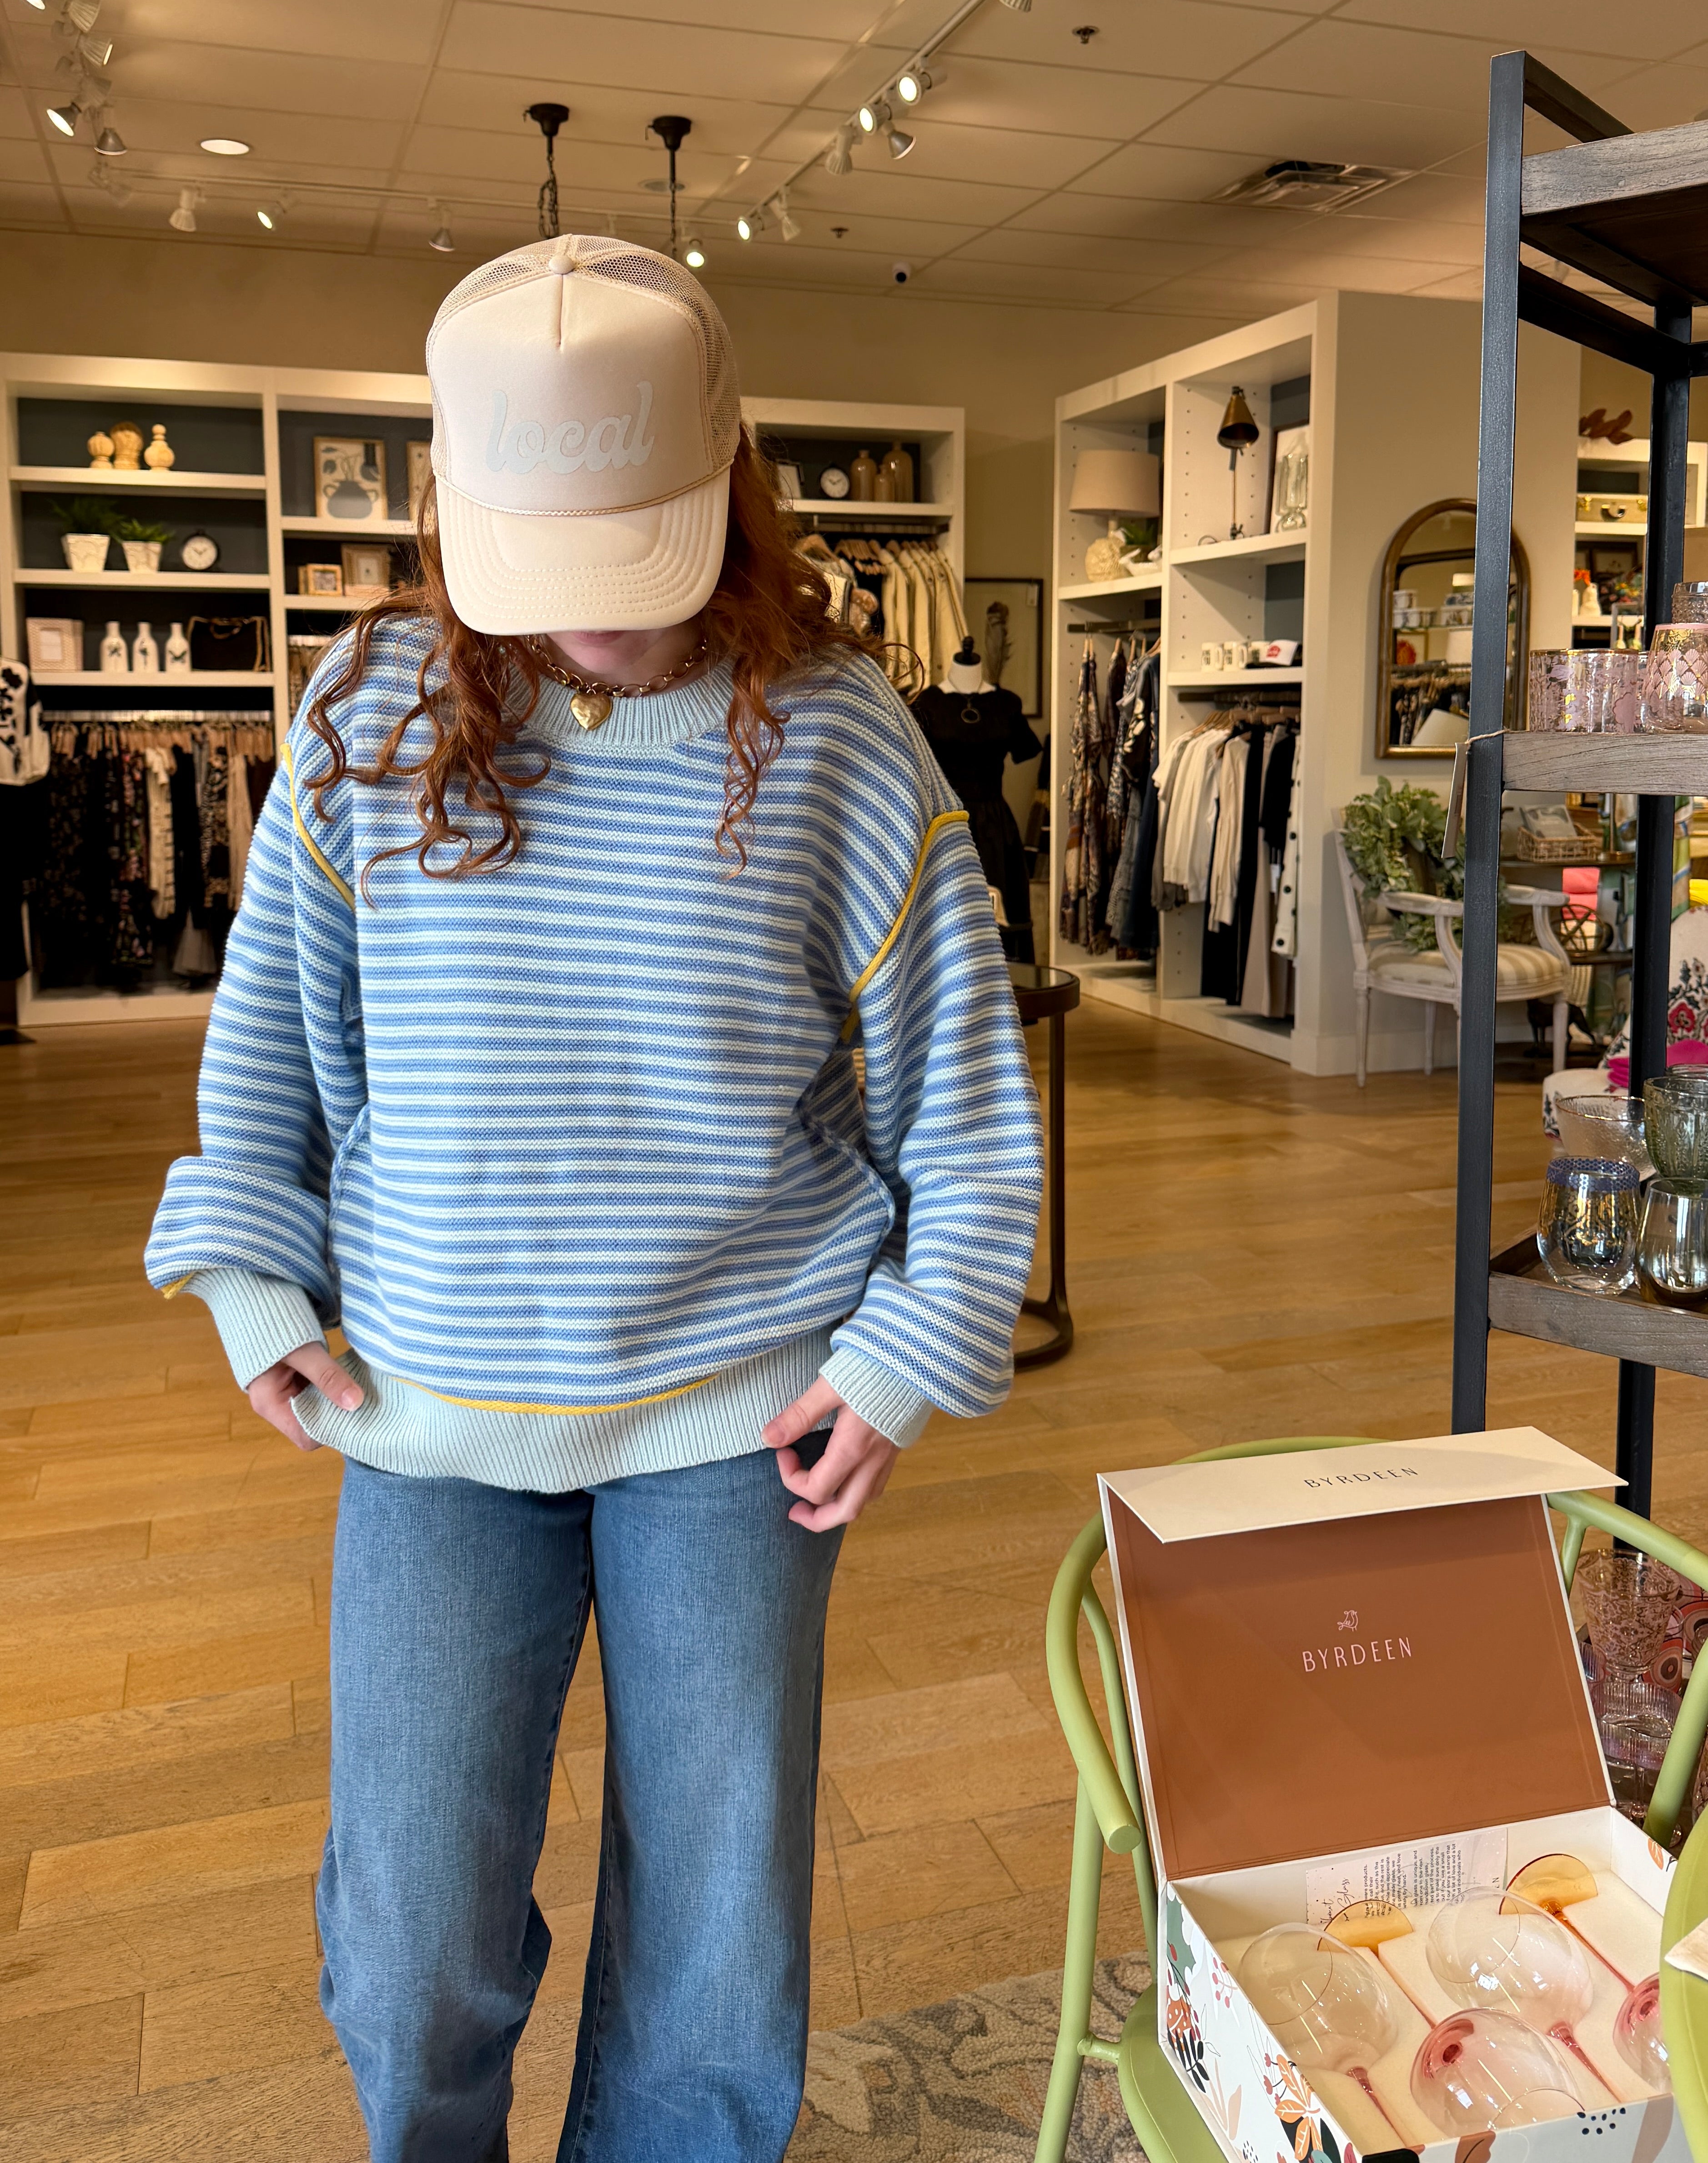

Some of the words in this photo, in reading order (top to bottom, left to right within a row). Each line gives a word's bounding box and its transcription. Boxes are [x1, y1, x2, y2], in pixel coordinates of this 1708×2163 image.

[486, 381, 655, 475] local
[1303, 1467, 1418, 1488] BYRDEEN
[1302, 1637, 1412, 1672] BYRDEEN
